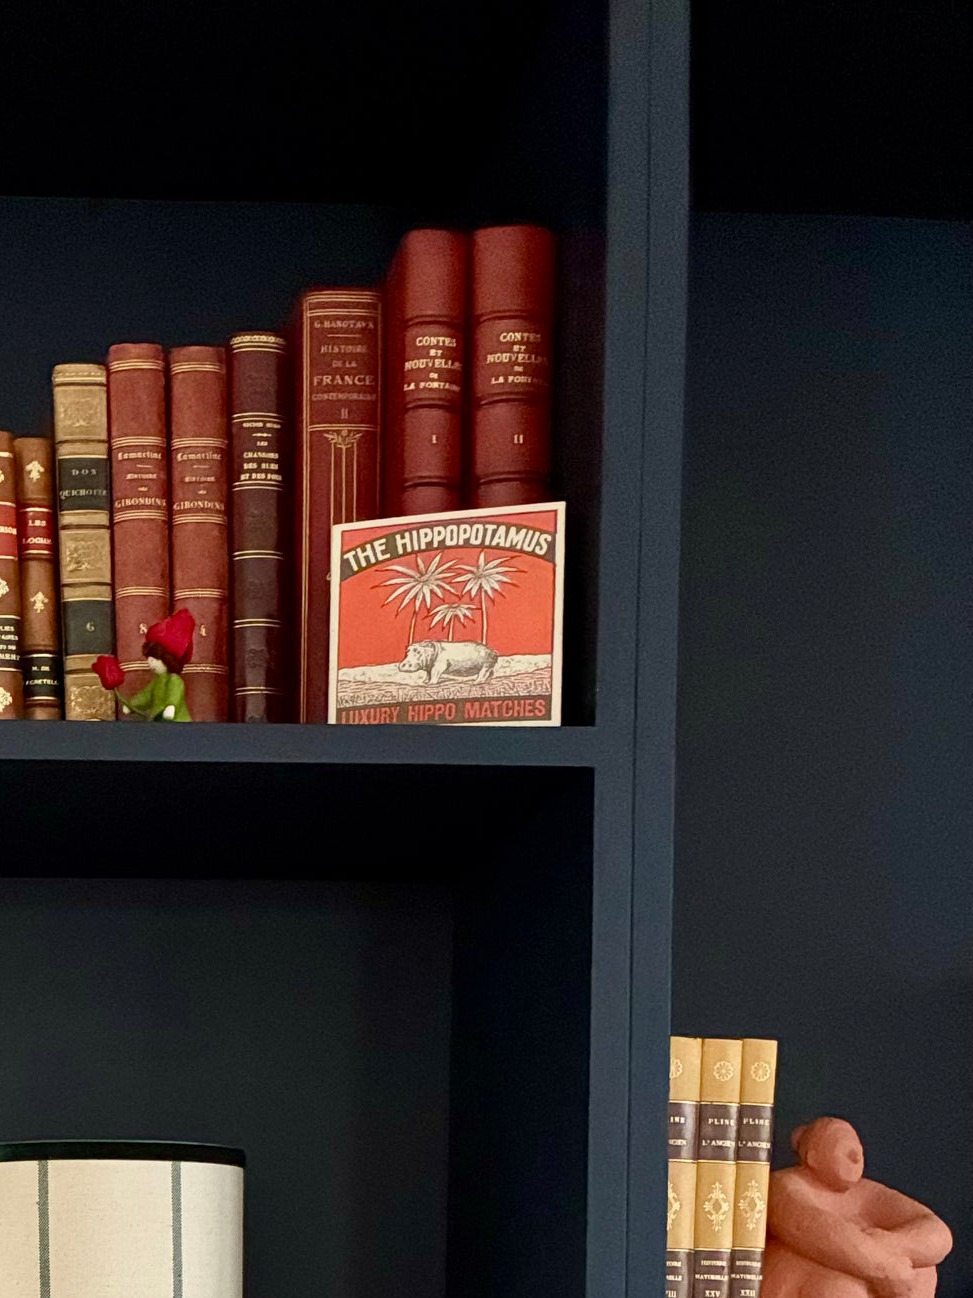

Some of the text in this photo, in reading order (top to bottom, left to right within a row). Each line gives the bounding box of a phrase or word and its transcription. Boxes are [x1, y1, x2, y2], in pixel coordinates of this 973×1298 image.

[416, 336, 457, 348] CONTES
[500, 332, 542, 342] CONTES
[320, 345, 368, 354] HISTOIRE
[429, 349, 443, 357] ET
[332, 360, 357, 368] DE LA
[313, 375, 375, 386] FRANCE
[490, 376, 505, 384] LA
[403, 383, 416, 392] LA
[431, 434, 438, 444] I
[513, 434, 524, 444] II
[243, 462, 258, 470] DES
[115, 497, 167, 508] GIRONDINS
[173, 500, 225, 511] GIRONDINS
[343, 523, 552, 572] THE HIPPOPOTAMUS
[342, 699, 546, 724] LUXURY HIPPO MATCHES
[708, 1117, 735, 1127] PLINE
[742, 1116, 770, 1126] PLINE
[704, 1289, 721, 1298] XXV
